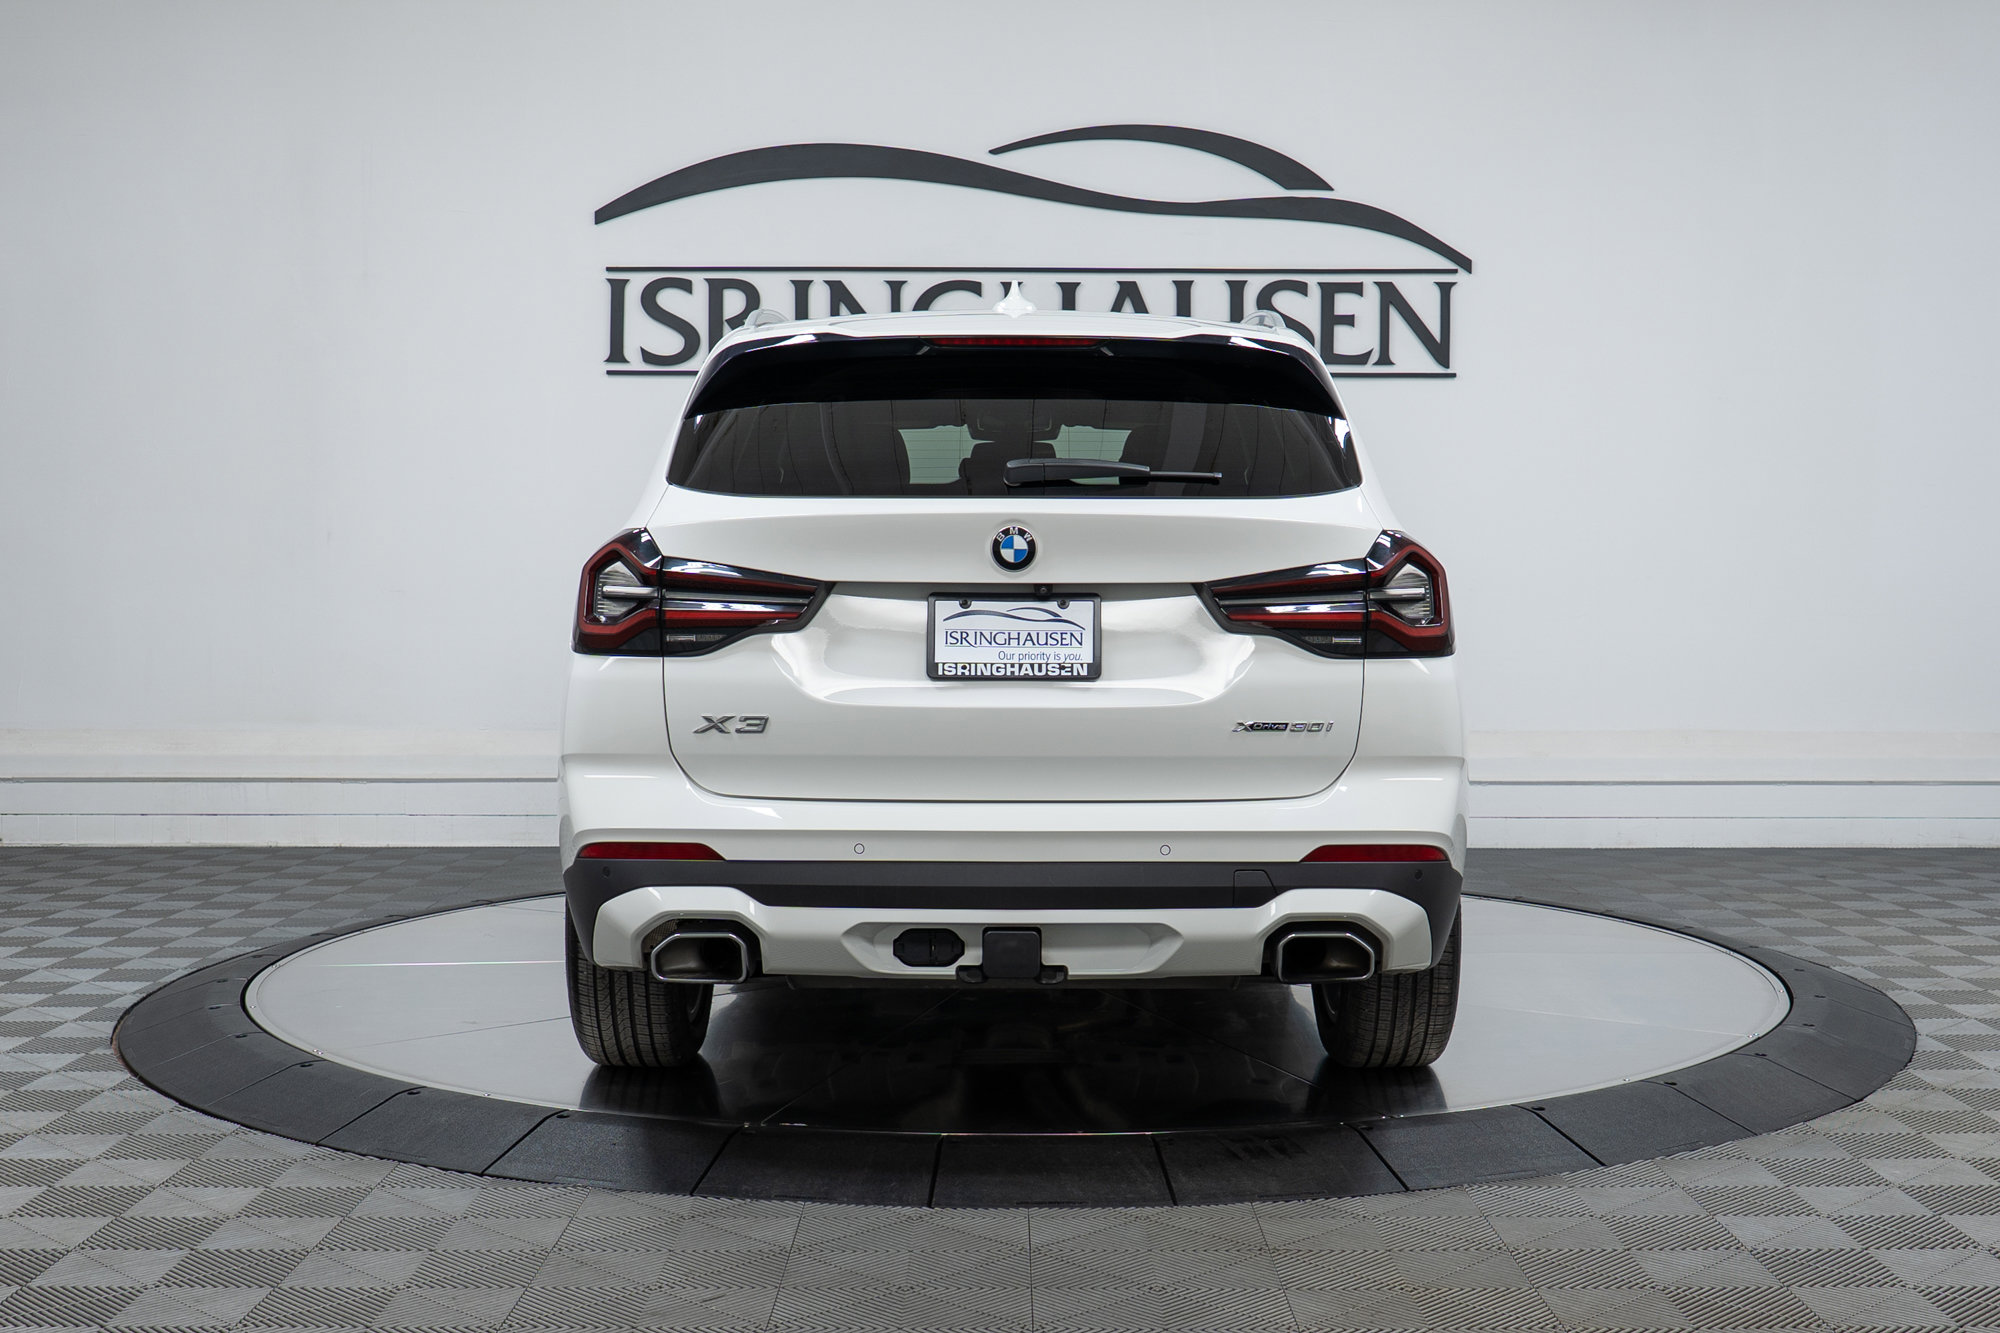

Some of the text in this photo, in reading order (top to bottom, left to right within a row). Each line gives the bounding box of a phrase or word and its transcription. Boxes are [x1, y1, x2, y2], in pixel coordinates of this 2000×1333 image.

[997, 526, 1033, 542] BMW
[945, 630, 1083, 648] ISRINGHAUSEN
[998, 650, 1083, 663] Our priority is you.
[938, 663, 1088, 676] ISRINGHAUSEN
[692, 715, 769, 734] X3
